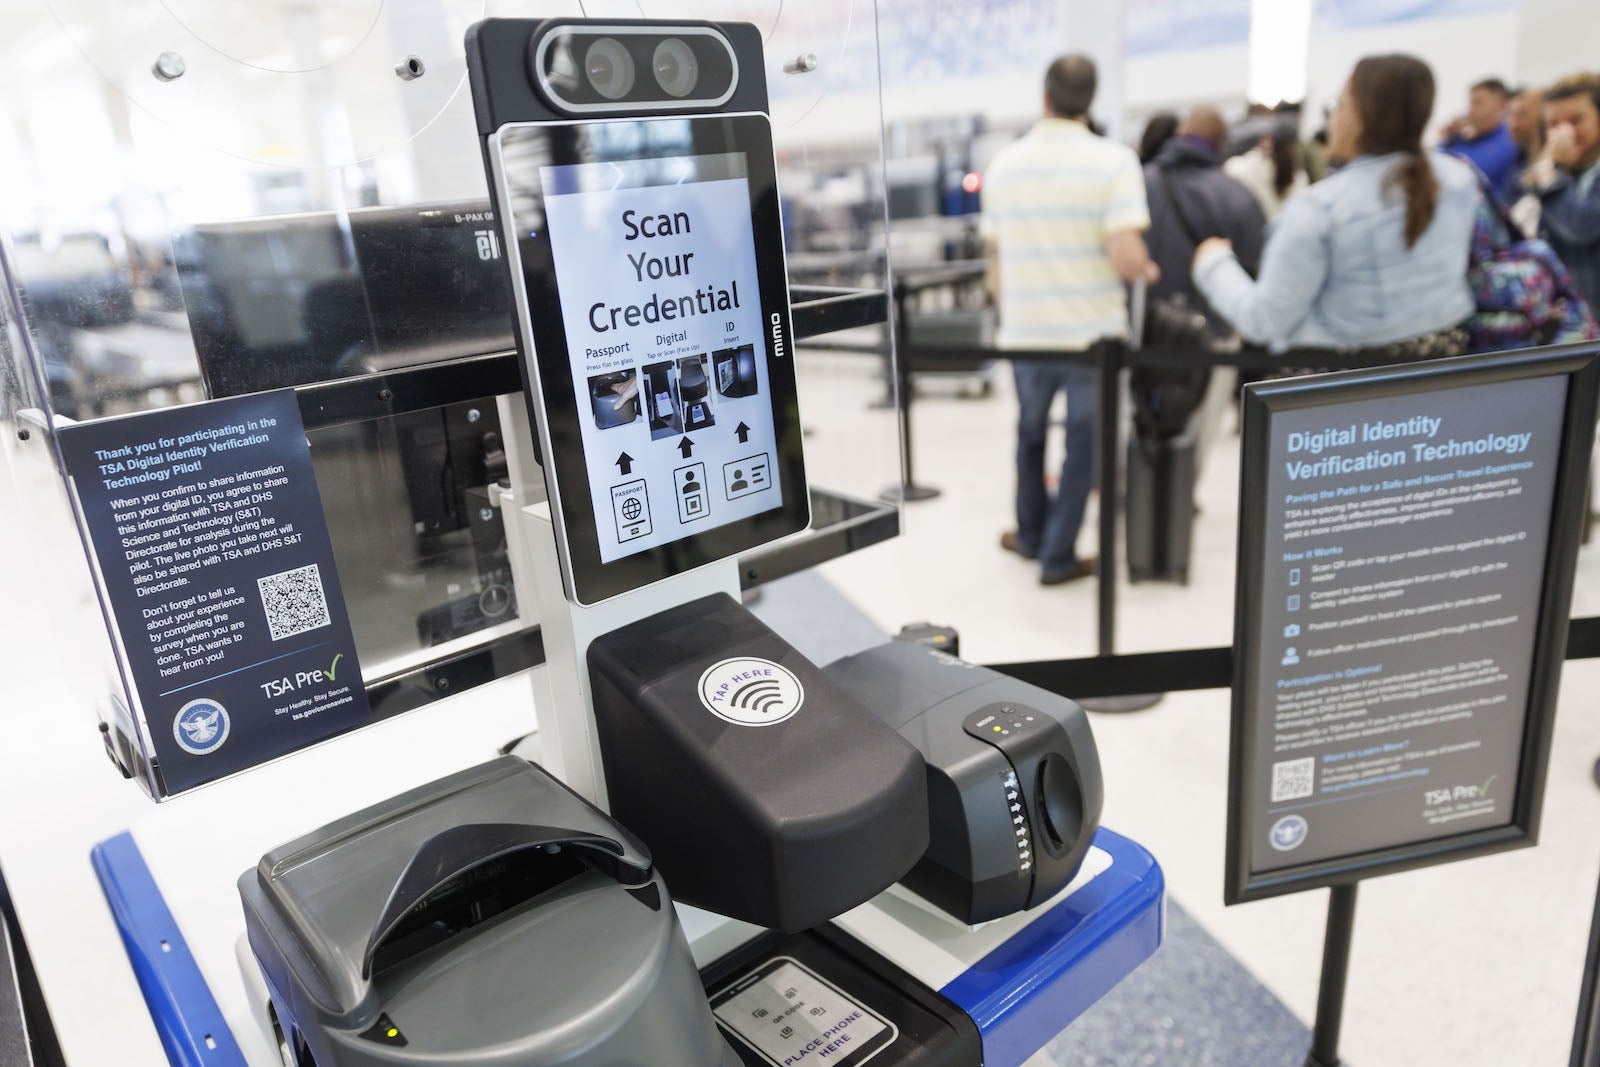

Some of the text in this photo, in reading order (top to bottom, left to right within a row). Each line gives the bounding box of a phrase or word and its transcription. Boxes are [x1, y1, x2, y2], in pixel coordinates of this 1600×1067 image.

[454, 213, 484, 223] B-PAX
[622, 210, 691, 241] Scan
[627, 252, 694, 282] Your
[589, 280, 740, 333] Credential
[656, 330, 687, 346] Digital
[723, 335, 740, 343] Insert
[725, 322, 735, 332] ID
[771, 312, 785, 357] mimo
[586, 342, 630, 359] Passport
[621, 358, 634, 366] glass
[677, 346, 690, 354] (Face
[95, 418, 276, 460] Thank you for participating in the
[1288, 416, 1441, 453] Digital Identity
[99, 434, 268, 474] TSA Digital Identity Verification
[1286, 432, 1531, 480] Verification Technology
[103, 460, 201, 489] Technology Pilot!
[110, 497, 139, 509] When
[141, 493, 159, 504] you
[162, 485, 196, 497] confirm
[209, 476, 234, 487] share
[236, 465, 284, 481] information
[114, 477, 287, 522] from your digital ID, you agree to share
[615, 486, 643, 497] PASSPORT
[118, 491, 272, 534] this information with TSA and DHS
[122, 507, 260, 547] Science and Technology (S&T)
[125, 517, 274, 559] Directorate for analysis during the
[129, 523, 292, 574] pilot. The live photo you take next will
[133, 533, 301, 584] also be shared with TSA and DHS S&T
[136, 578, 189, 596] Directorate.
[169, 596, 196, 610] forget
[197, 594, 206, 602] to
[208, 588, 222, 599] tell
[147, 597, 244, 629] about your experience
[149, 614, 228, 642] by completing the
[153, 621, 244, 653] survey when you are
[157, 653, 182, 665] done.
[184, 644, 204, 655] TSA
[205, 637, 231, 649] wants
[160, 650, 224, 676] hear from you!
[260, 670, 322, 698] TSA Pre
[713, 669, 772, 701] TAP HERE
[274, 706, 288, 714] Stay
[313, 693, 326, 701] Stay
[292, 696, 352, 719] tsa.gov/coronavirus
[1424, 785, 1477, 803] TSA Pre
[773, 1002, 805, 1024] QR CODE
[784, 1011, 863, 1067] PLACE PHONE
[819, 1034, 852, 1058] HERE
